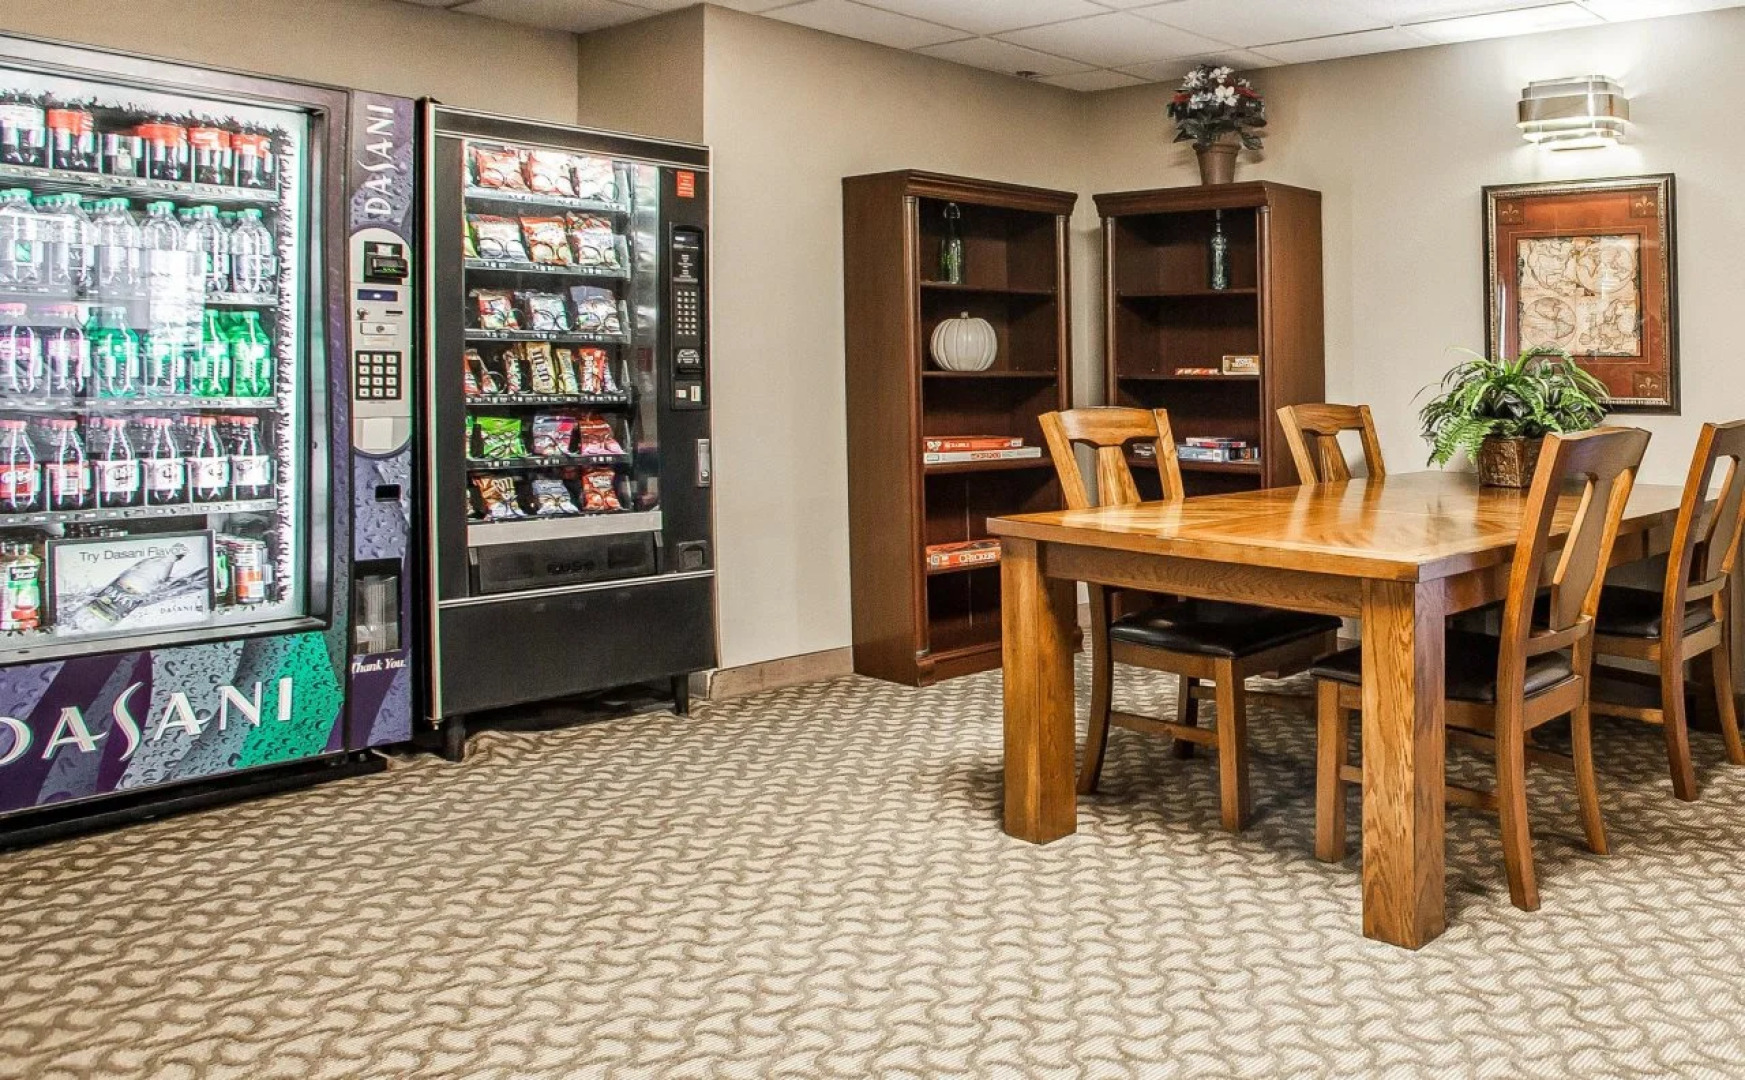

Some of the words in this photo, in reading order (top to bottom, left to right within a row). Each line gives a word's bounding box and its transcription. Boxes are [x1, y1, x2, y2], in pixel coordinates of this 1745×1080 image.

[357, 103, 400, 216] DASANI
[79, 551, 100, 564] Try
[104, 548, 146, 561] Dasani
